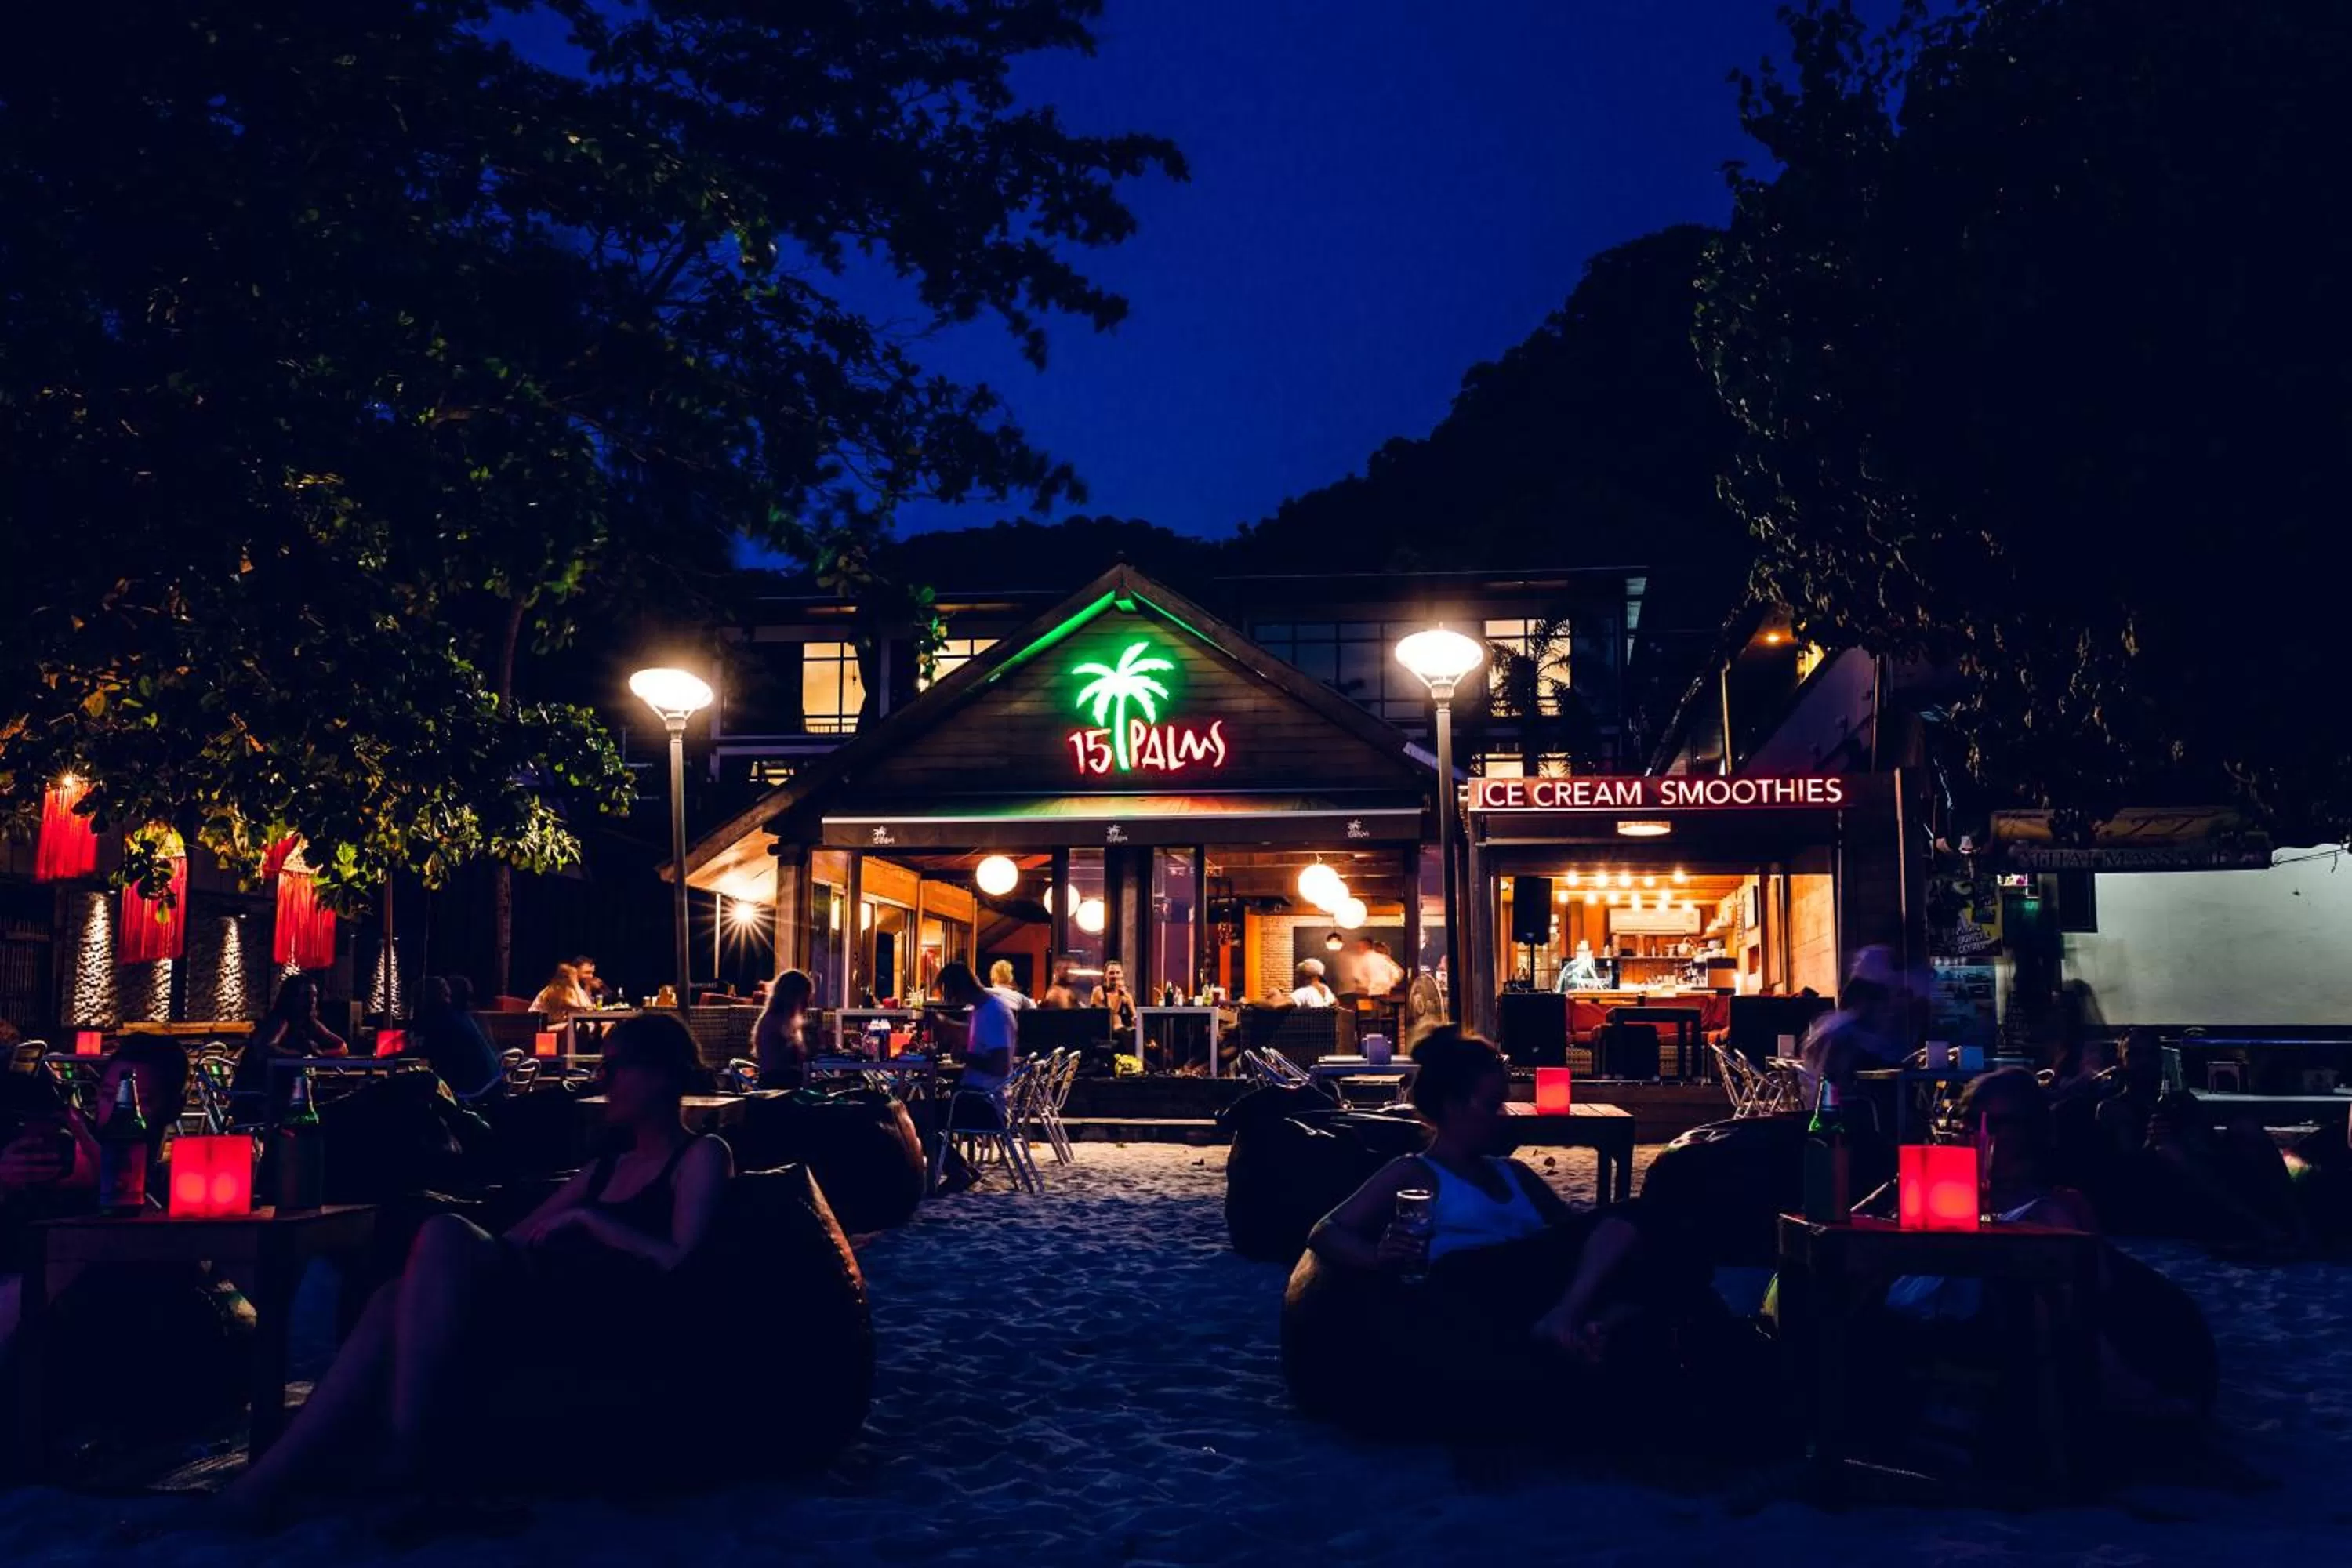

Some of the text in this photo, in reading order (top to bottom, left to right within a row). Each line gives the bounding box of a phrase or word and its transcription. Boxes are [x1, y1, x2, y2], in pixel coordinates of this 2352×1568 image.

[1069, 718, 1226, 775] 15 PALMS
[1478, 777, 1843, 807] ICE CREAM SMOOTHIES
